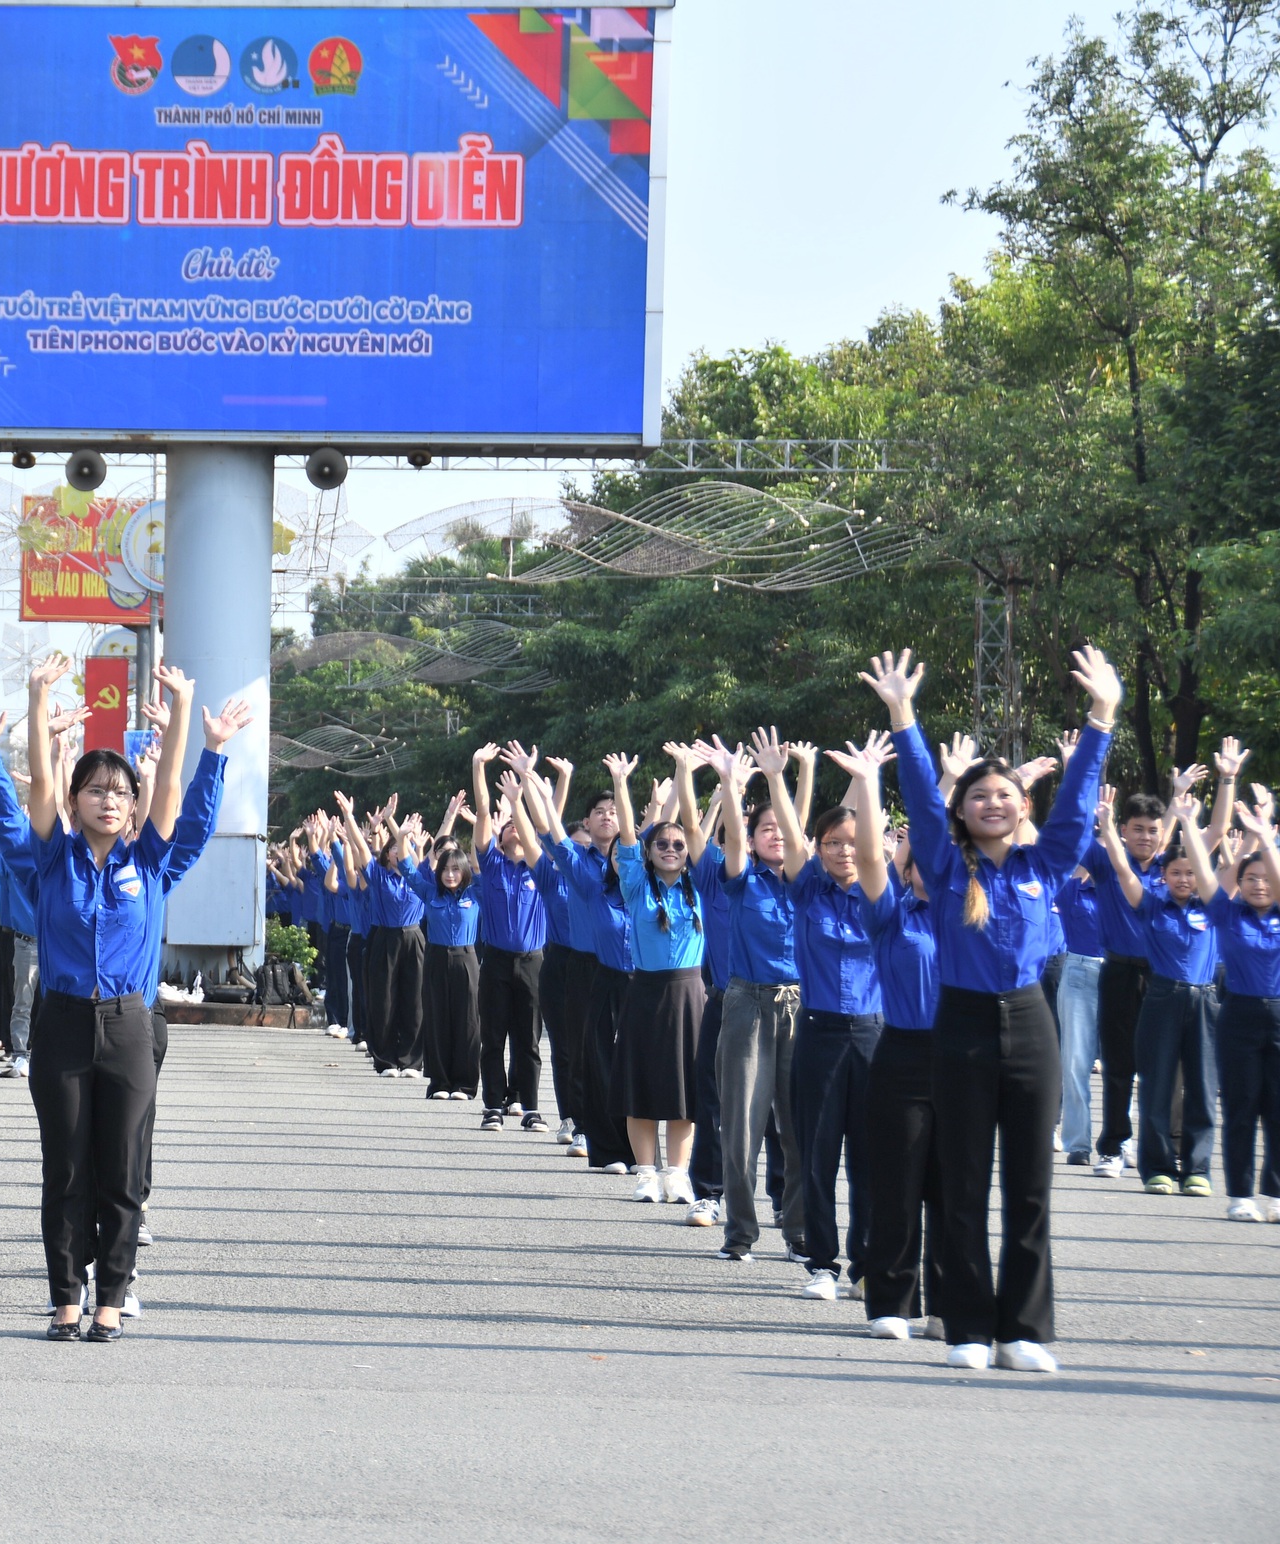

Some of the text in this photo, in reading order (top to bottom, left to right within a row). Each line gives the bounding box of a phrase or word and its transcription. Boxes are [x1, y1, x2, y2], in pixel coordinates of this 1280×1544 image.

[155, 103, 322, 125] THÀNH PHỐ HỒ CHÍ MINH
[136, 145, 269, 221] TRÌNH
[281, 138, 404, 221] ĐỒNG
[415, 138, 519, 222] DIỄN
[183, 246, 234, 280] Chủ
[45, 292, 84, 318] TRẺ
[87, 294, 134, 323] VIỆT
[138, 300, 186, 320] NAM
[190, 296, 249, 321] VỮNG
[255, 296, 316, 321] BƯỚC
[318, 296, 371, 321] DƯỚI
[375, 296, 407, 321] CỜ
[410, 295, 471, 322] ĐẢNG
[29, 327, 431, 354] TIÊN PHONG BƯỚC VÀO KỶ NGUYÊN MỚI
[57, 565, 79, 598] VÀO
